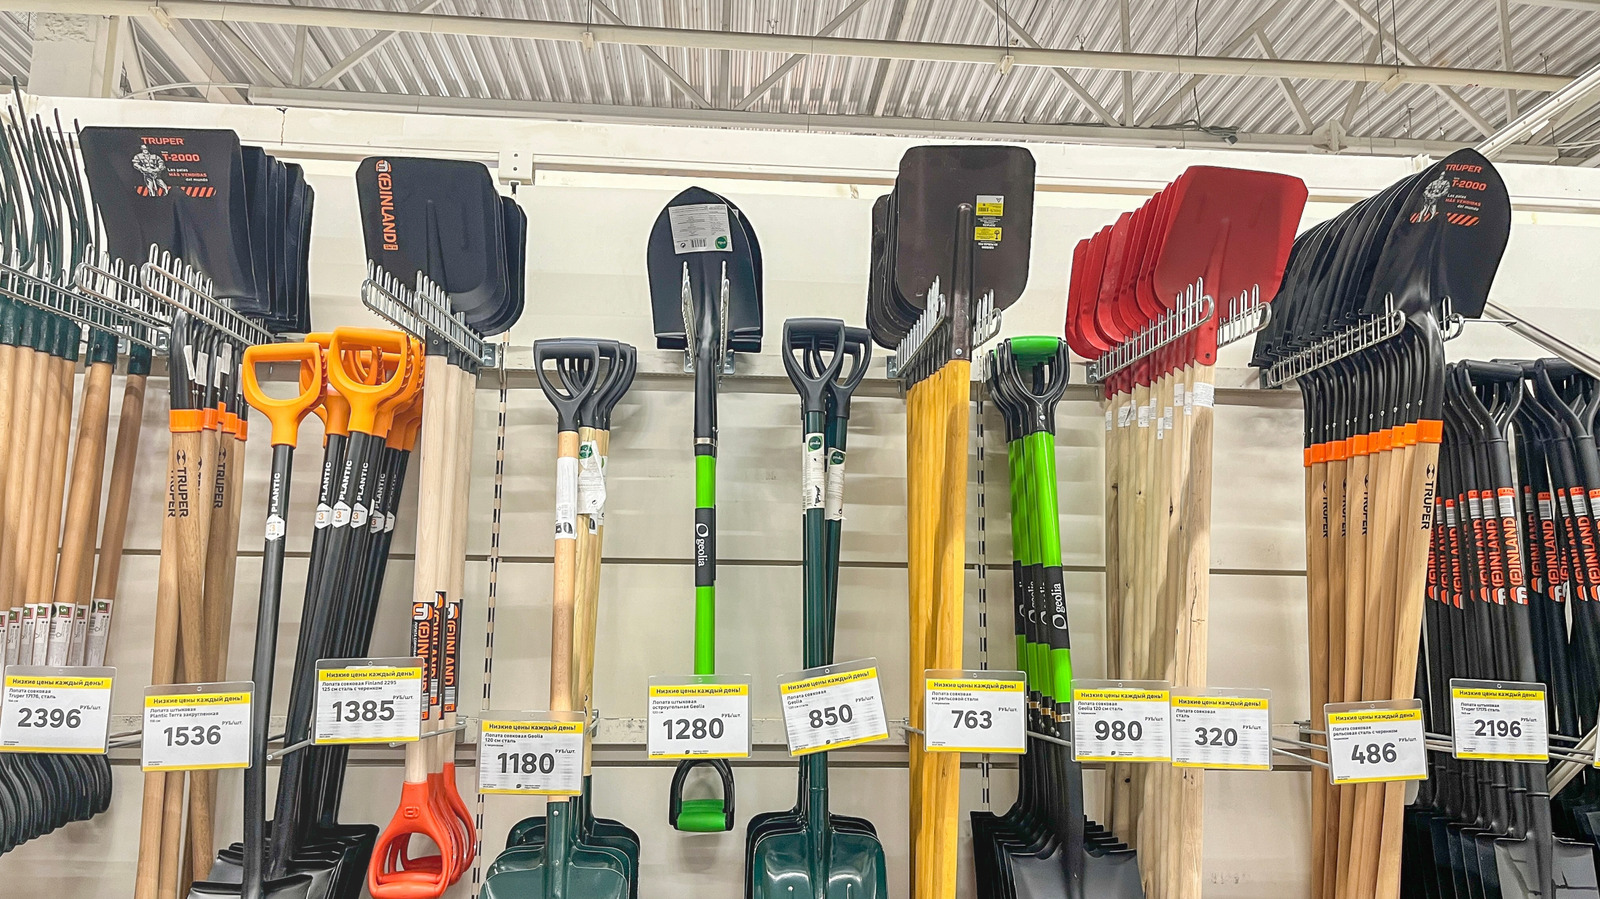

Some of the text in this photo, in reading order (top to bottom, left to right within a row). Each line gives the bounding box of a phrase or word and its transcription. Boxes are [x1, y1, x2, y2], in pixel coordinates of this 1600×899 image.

[141, 137, 184, 145] TRUPER
[162, 154, 200, 162] T-2000
[1445, 164, 1482, 173] TRUPER
[1452, 180, 1487, 191] T-2000
[214, 463, 225, 508] TRUPER
[321, 461, 332, 501] PLANTIC
[339, 460, 353, 501] PLANTIC
[357, 462, 368, 501] PLANTIC
[375, 473, 385, 509] PLANTIC
[177, 467, 188, 517] TRUPER
[271, 473, 281, 513] PLANTIC
[336, 511, 342, 519] 3
[1421, 481, 1434, 530] TRUPER
[696, 539, 708, 566] geolia
[1485, 519, 1504, 587] FINLAND
[1502, 517, 1523, 586] FINLAND
[1542, 520, 1559, 584] FINLAND
[1577, 516, 1600, 584] FINLAND
[1051, 583, 1065, 613] geolia
[811, 680, 827, 688] цены
[828, 675, 852, 683] каждый
[853, 671, 870, 679] день!
[18, 708, 81, 728] 2396
[332, 700, 394, 722] 1385
[809, 704, 853, 728] 850
[951, 710, 992, 729] 763
[164, 725, 221, 746] 1536
[663, 718, 724, 740] 1280
[1094, 720, 1142, 741] 980
[1195, 727, 1238, 746] 320
[1474, 719, 1522, 737] 2196
[497, 753, 554, 774] 1180
[1351, 742, 1397, 764] 486
